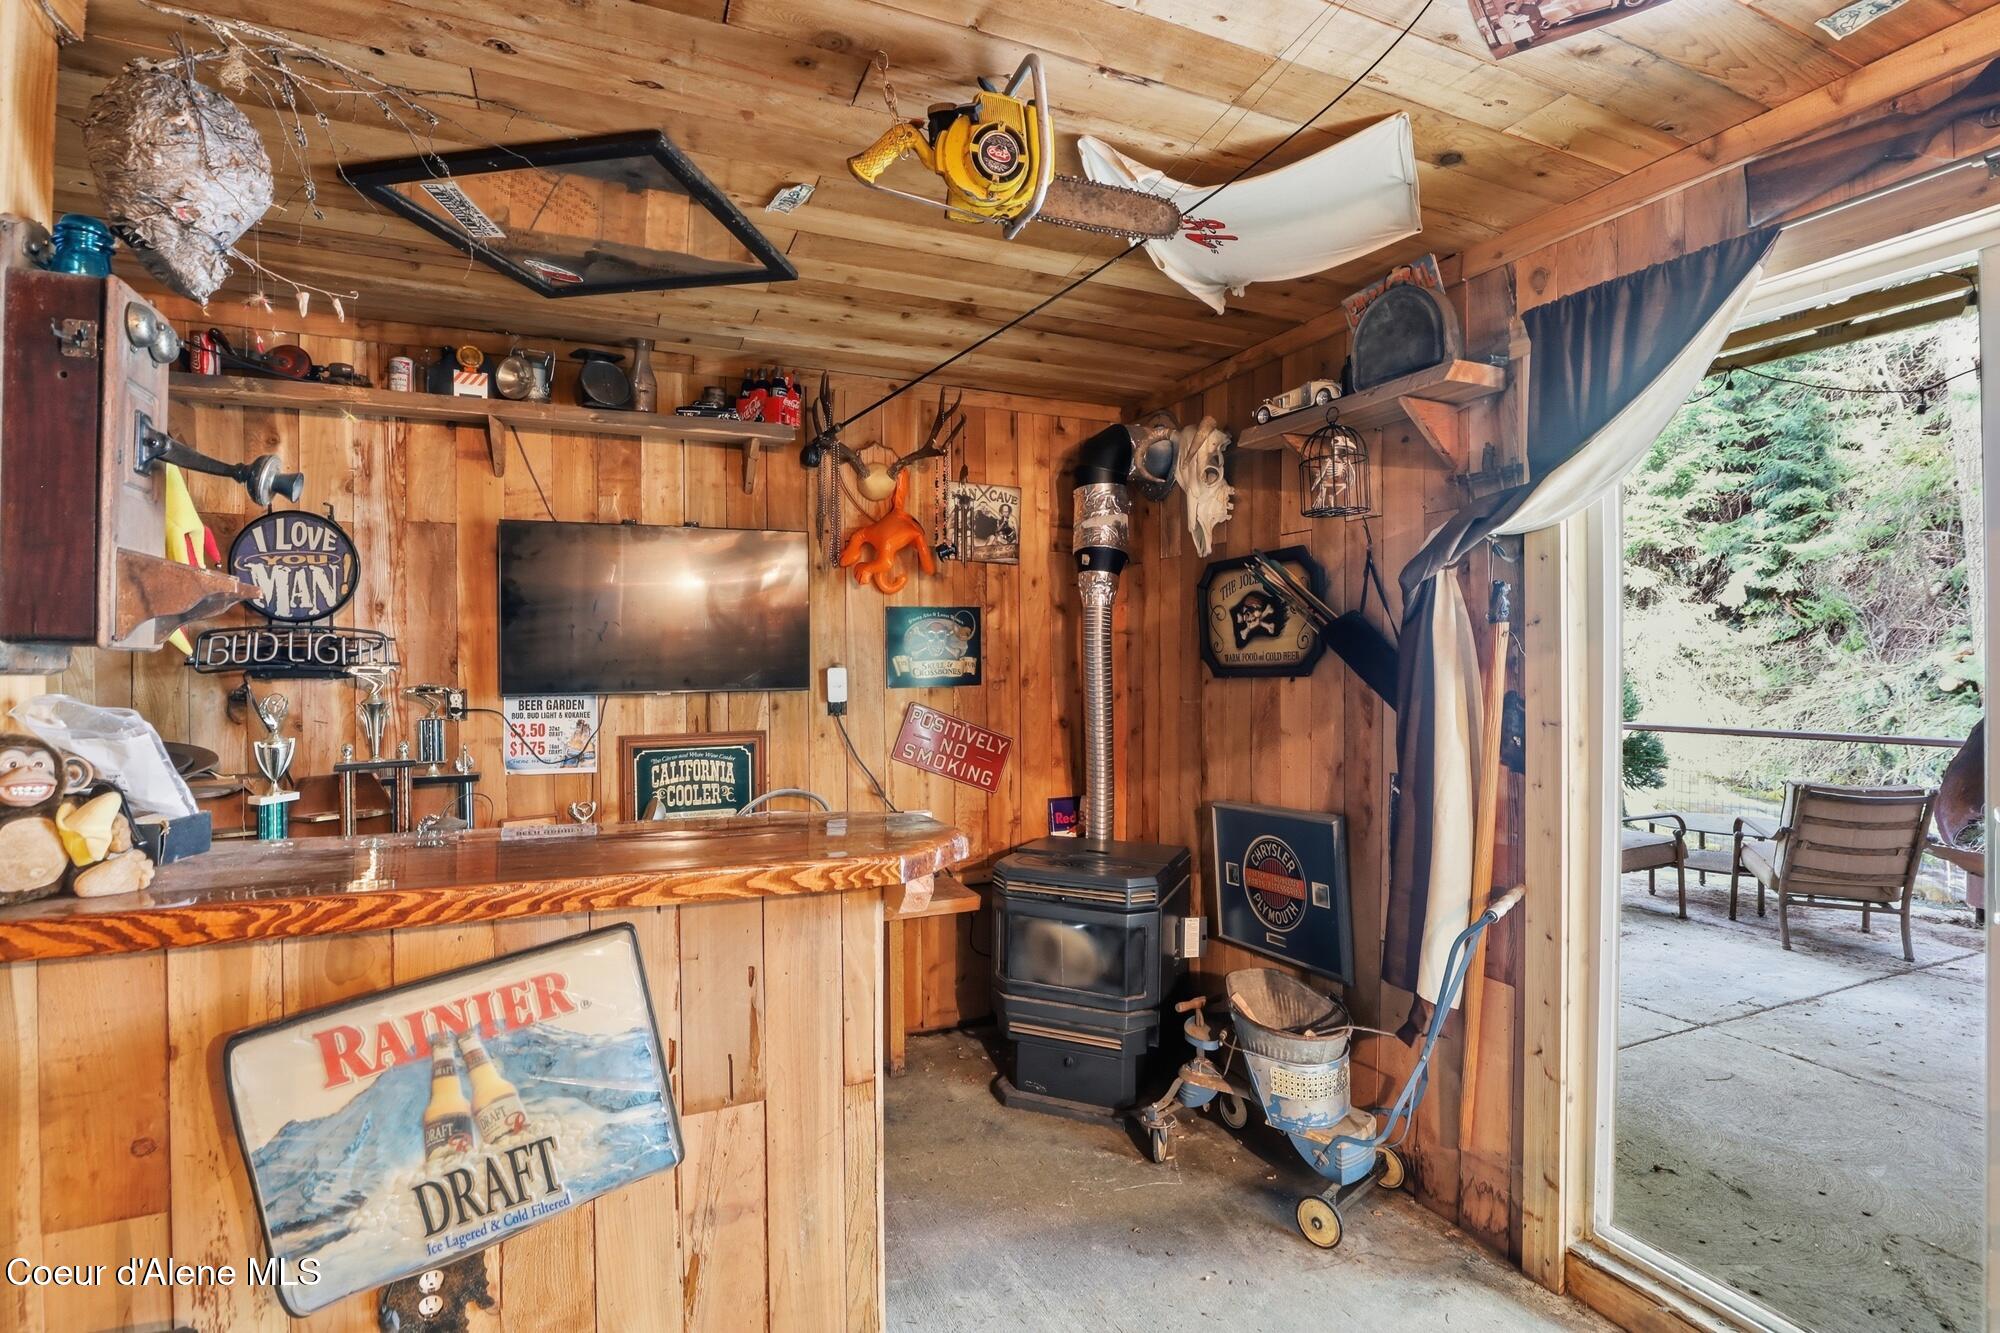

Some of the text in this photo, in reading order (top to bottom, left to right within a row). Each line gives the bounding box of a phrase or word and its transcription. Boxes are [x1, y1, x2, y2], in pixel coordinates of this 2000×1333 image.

[989, 490, 1018, 505] CAVE
[252, 518, 338, 552] I LOVE
[260, 554, 329, 566] YOU
[1220, 573, 1259, 601] THE JOL
[206, 632, 380, 666] BUD LIGHT
[1242, 652, 1258, 661] FOOD
[1265, 651, 1282, 661] COLD
[1282, 650, 1300, 660] BEER
[922, 662, 944, 670] SKULL
[511, 712, 526, 720] BUD,
[541, 711, 557, 719] LIGHT
[564, 711, 591, 719] KOKANEE
[518, 699, 585, 711] BEER GARDEN
[510, 722, 546, 738] $3.50
[909, 708, 1008, 755] POSITIVELY
[509, 741, 546, 757] $1.75
[939, 738, 968, 760] NO
[651, 759, 736, 789] CALIFORNIA
[902, 743, 994, 786] SMOKING
[667, 783, 722, 807] COOLER
[1055, 811, 1076, 825] Red
[1250, 843, 1296, 873] CHRYSLER
[1253, 892, 1299, 925] PLYMOUTH
[312, 971, 579, 1089] RAINIER
[480, 1105, 508, 1130] DRAFT
[425, 1122, 454, 1142] DRAFT
[411, 1136, 562, 1238] DRAFT
[427, 1193, 571, 1257] Ice Lagered & Cold Filtered
